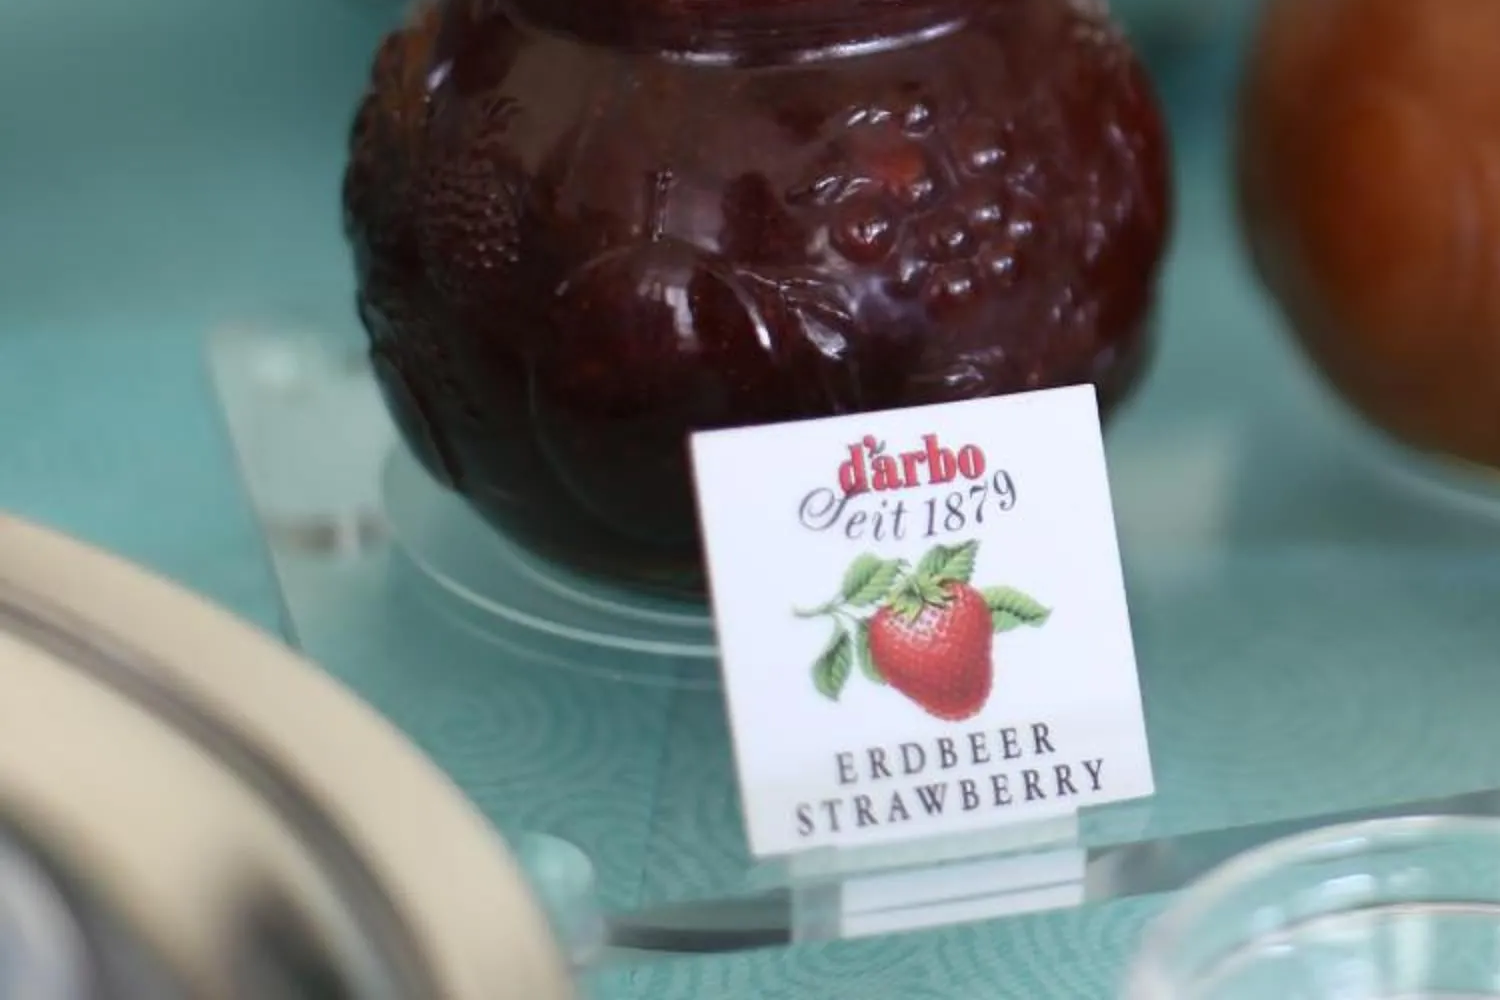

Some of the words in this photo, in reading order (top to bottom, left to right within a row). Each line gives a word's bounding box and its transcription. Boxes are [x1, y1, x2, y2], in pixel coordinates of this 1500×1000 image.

[799, 486, 907, 542] Seit
[922, 469, 1018, 539] 1879
[836, 722, 1056, 785] ERDBEER
[796, 758, 1106, 837] STRAWBERRY
